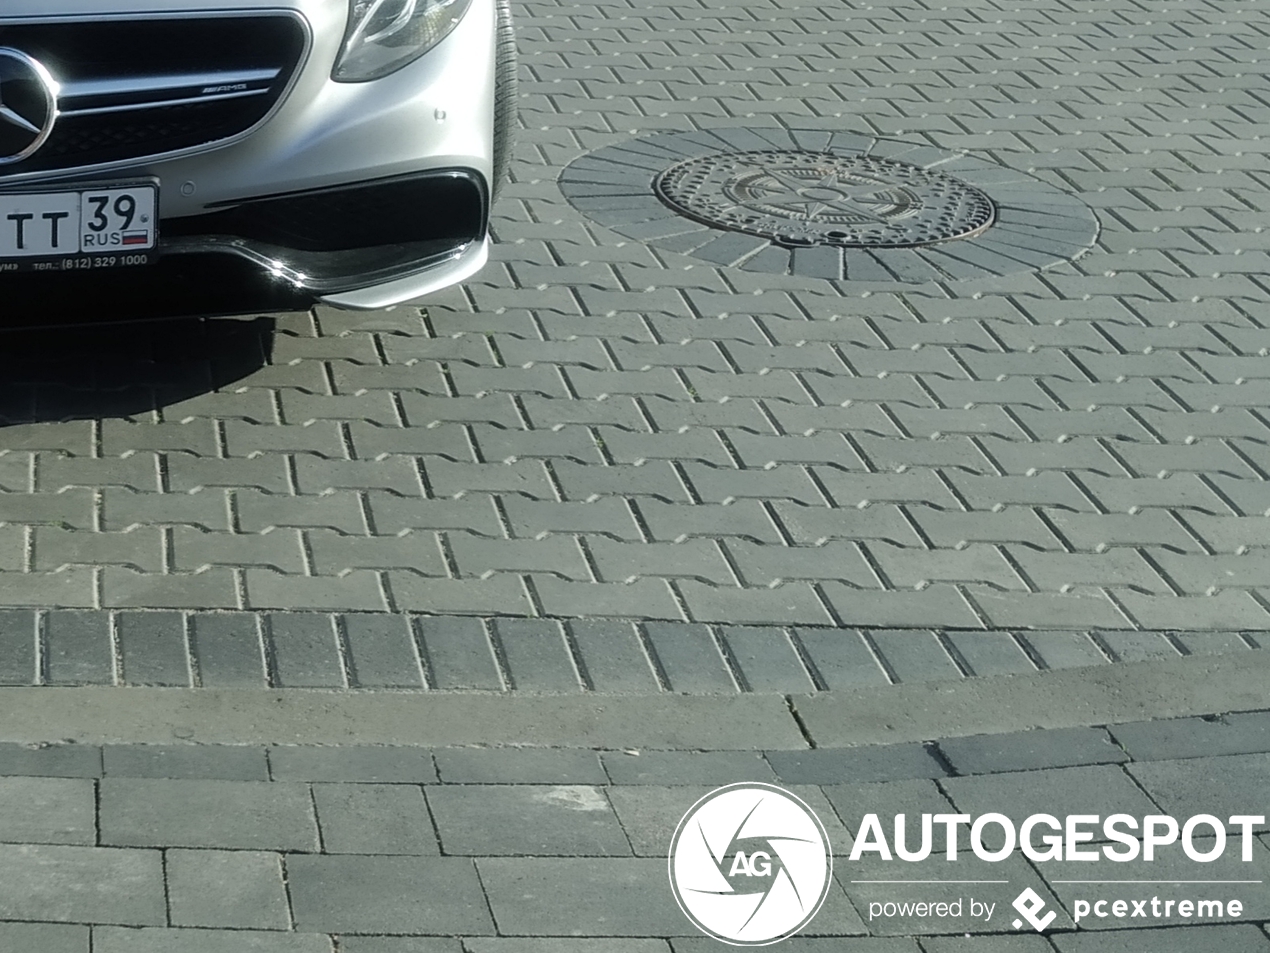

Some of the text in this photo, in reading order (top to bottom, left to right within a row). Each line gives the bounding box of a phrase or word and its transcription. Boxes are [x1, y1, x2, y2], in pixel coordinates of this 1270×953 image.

[215, 83, 247, 92] AMG
[87, 194, 136, 232] 39
[83, 231, 120, 247] RUS
[62, 256, 91, 270] (812)
[94, 256, 116, 267] 329
[121, 254, 147, 265] 1000
